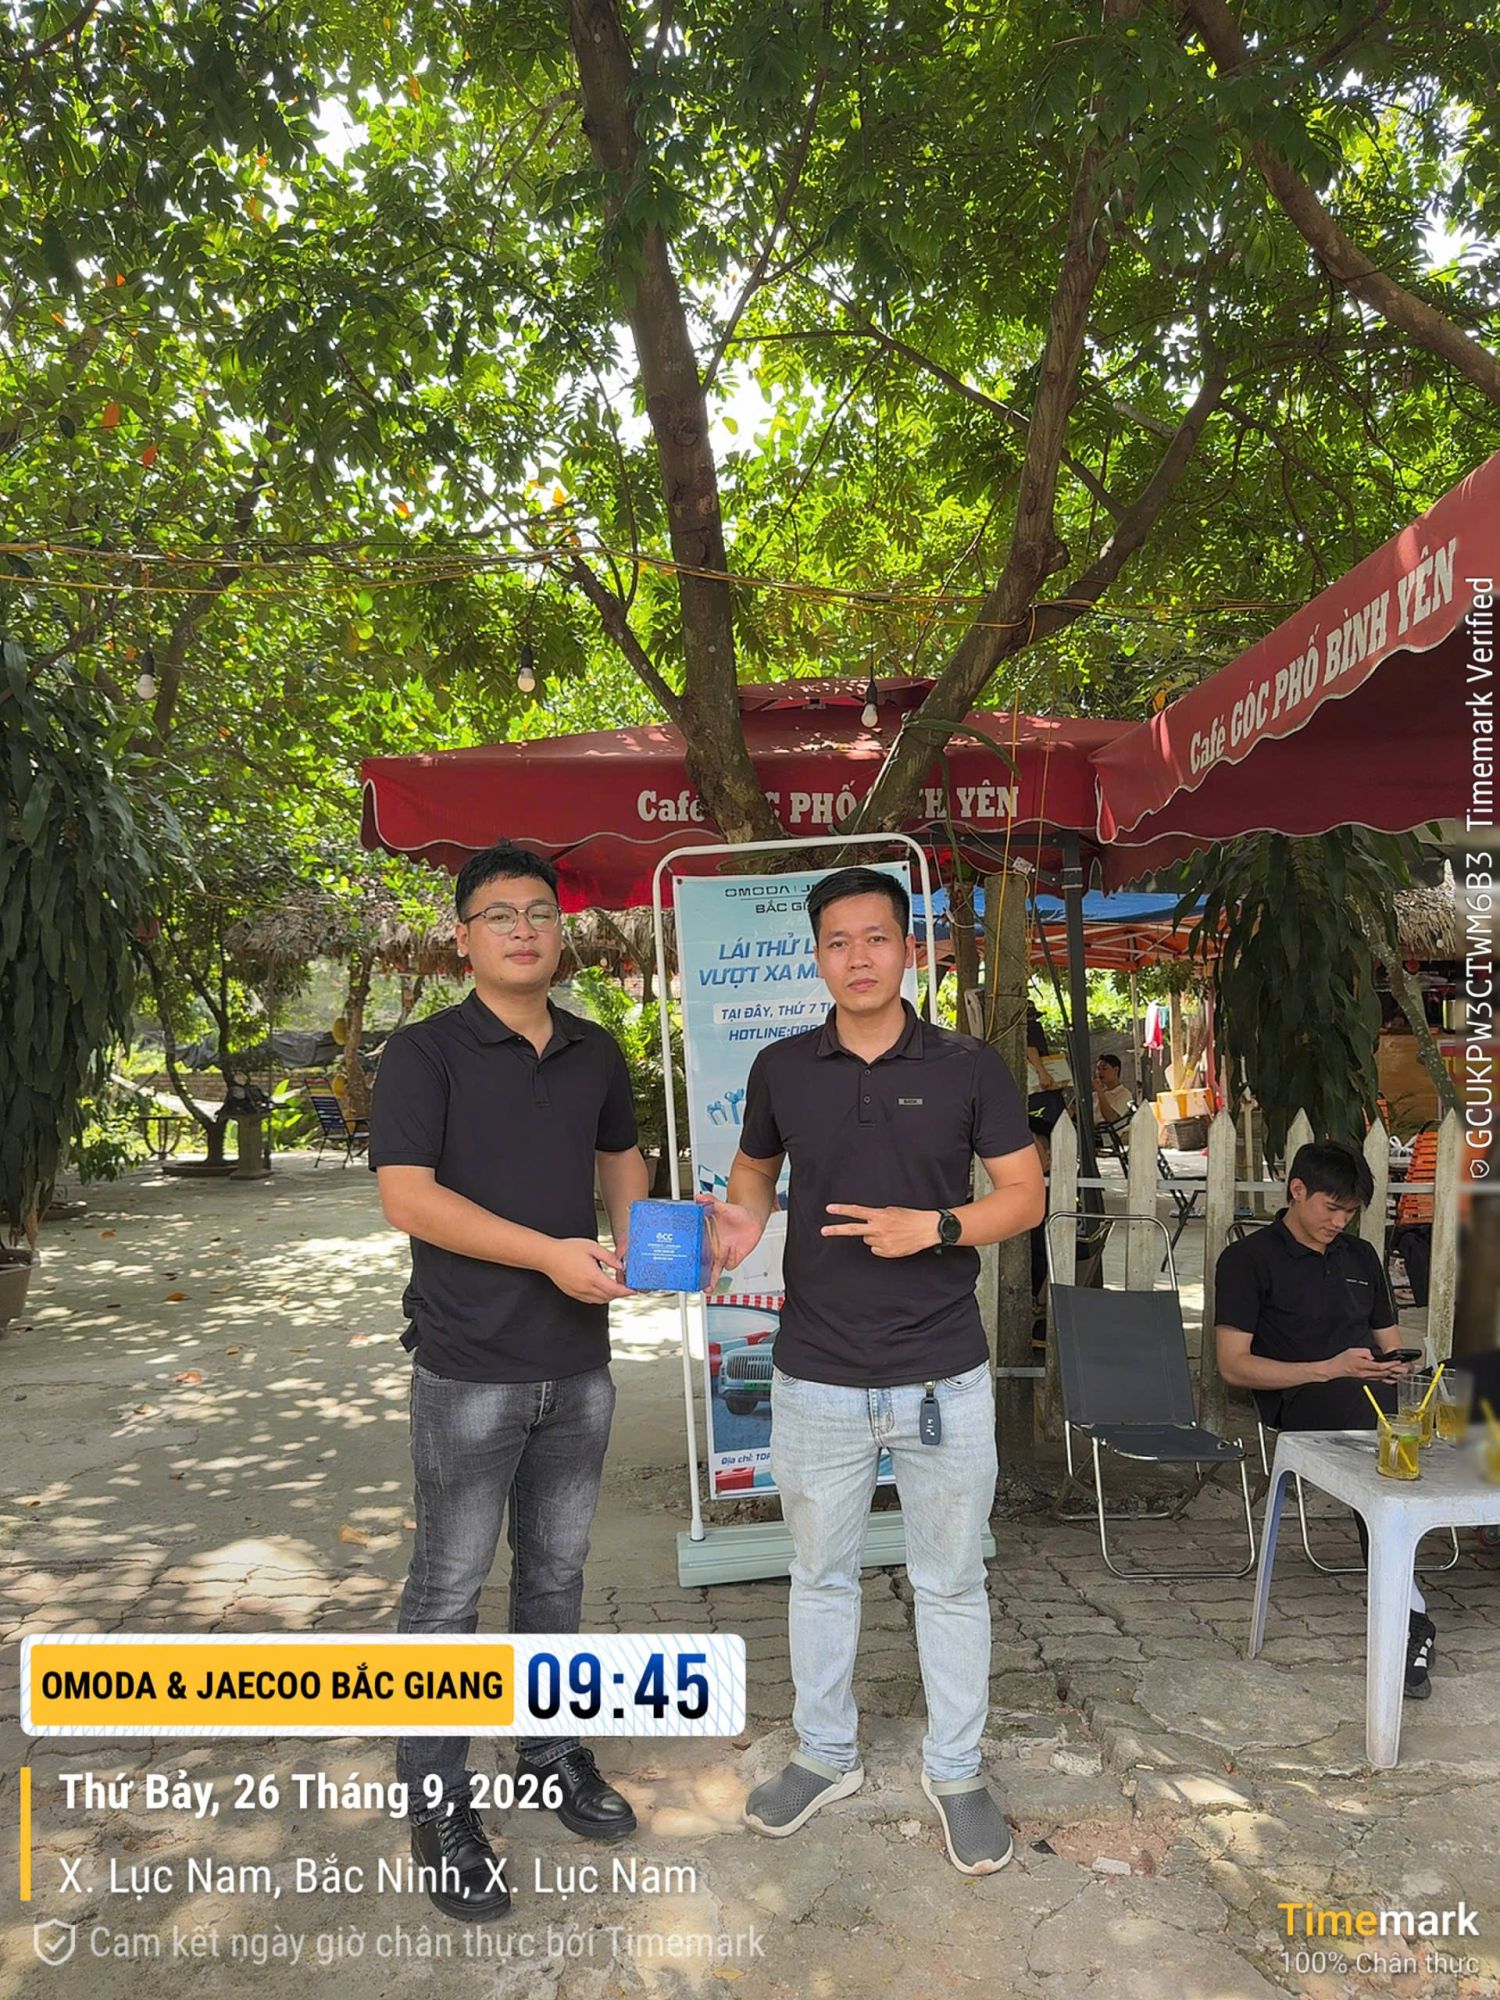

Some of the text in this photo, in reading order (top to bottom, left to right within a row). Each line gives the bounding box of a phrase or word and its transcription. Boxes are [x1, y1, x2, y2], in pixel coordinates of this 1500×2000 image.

[1190, 536, 1457, 775] Café GÓC PHỐ BÌNH YÊN
[956, 778, 1020, 818] YÊN
[725, 885, 790, 897] OMODA
[719, 937, 751, 960] LÁI
[755, 932, 801, 958] THỬ
[699, 966, 760, 988] VƯỢT
[763, 964, 792, 982] XA
[721, 1008, 741, 1022] TẠI
[778, 1001, 805, 1016] THỨ
[809, 1003, 817, 1014] 7
